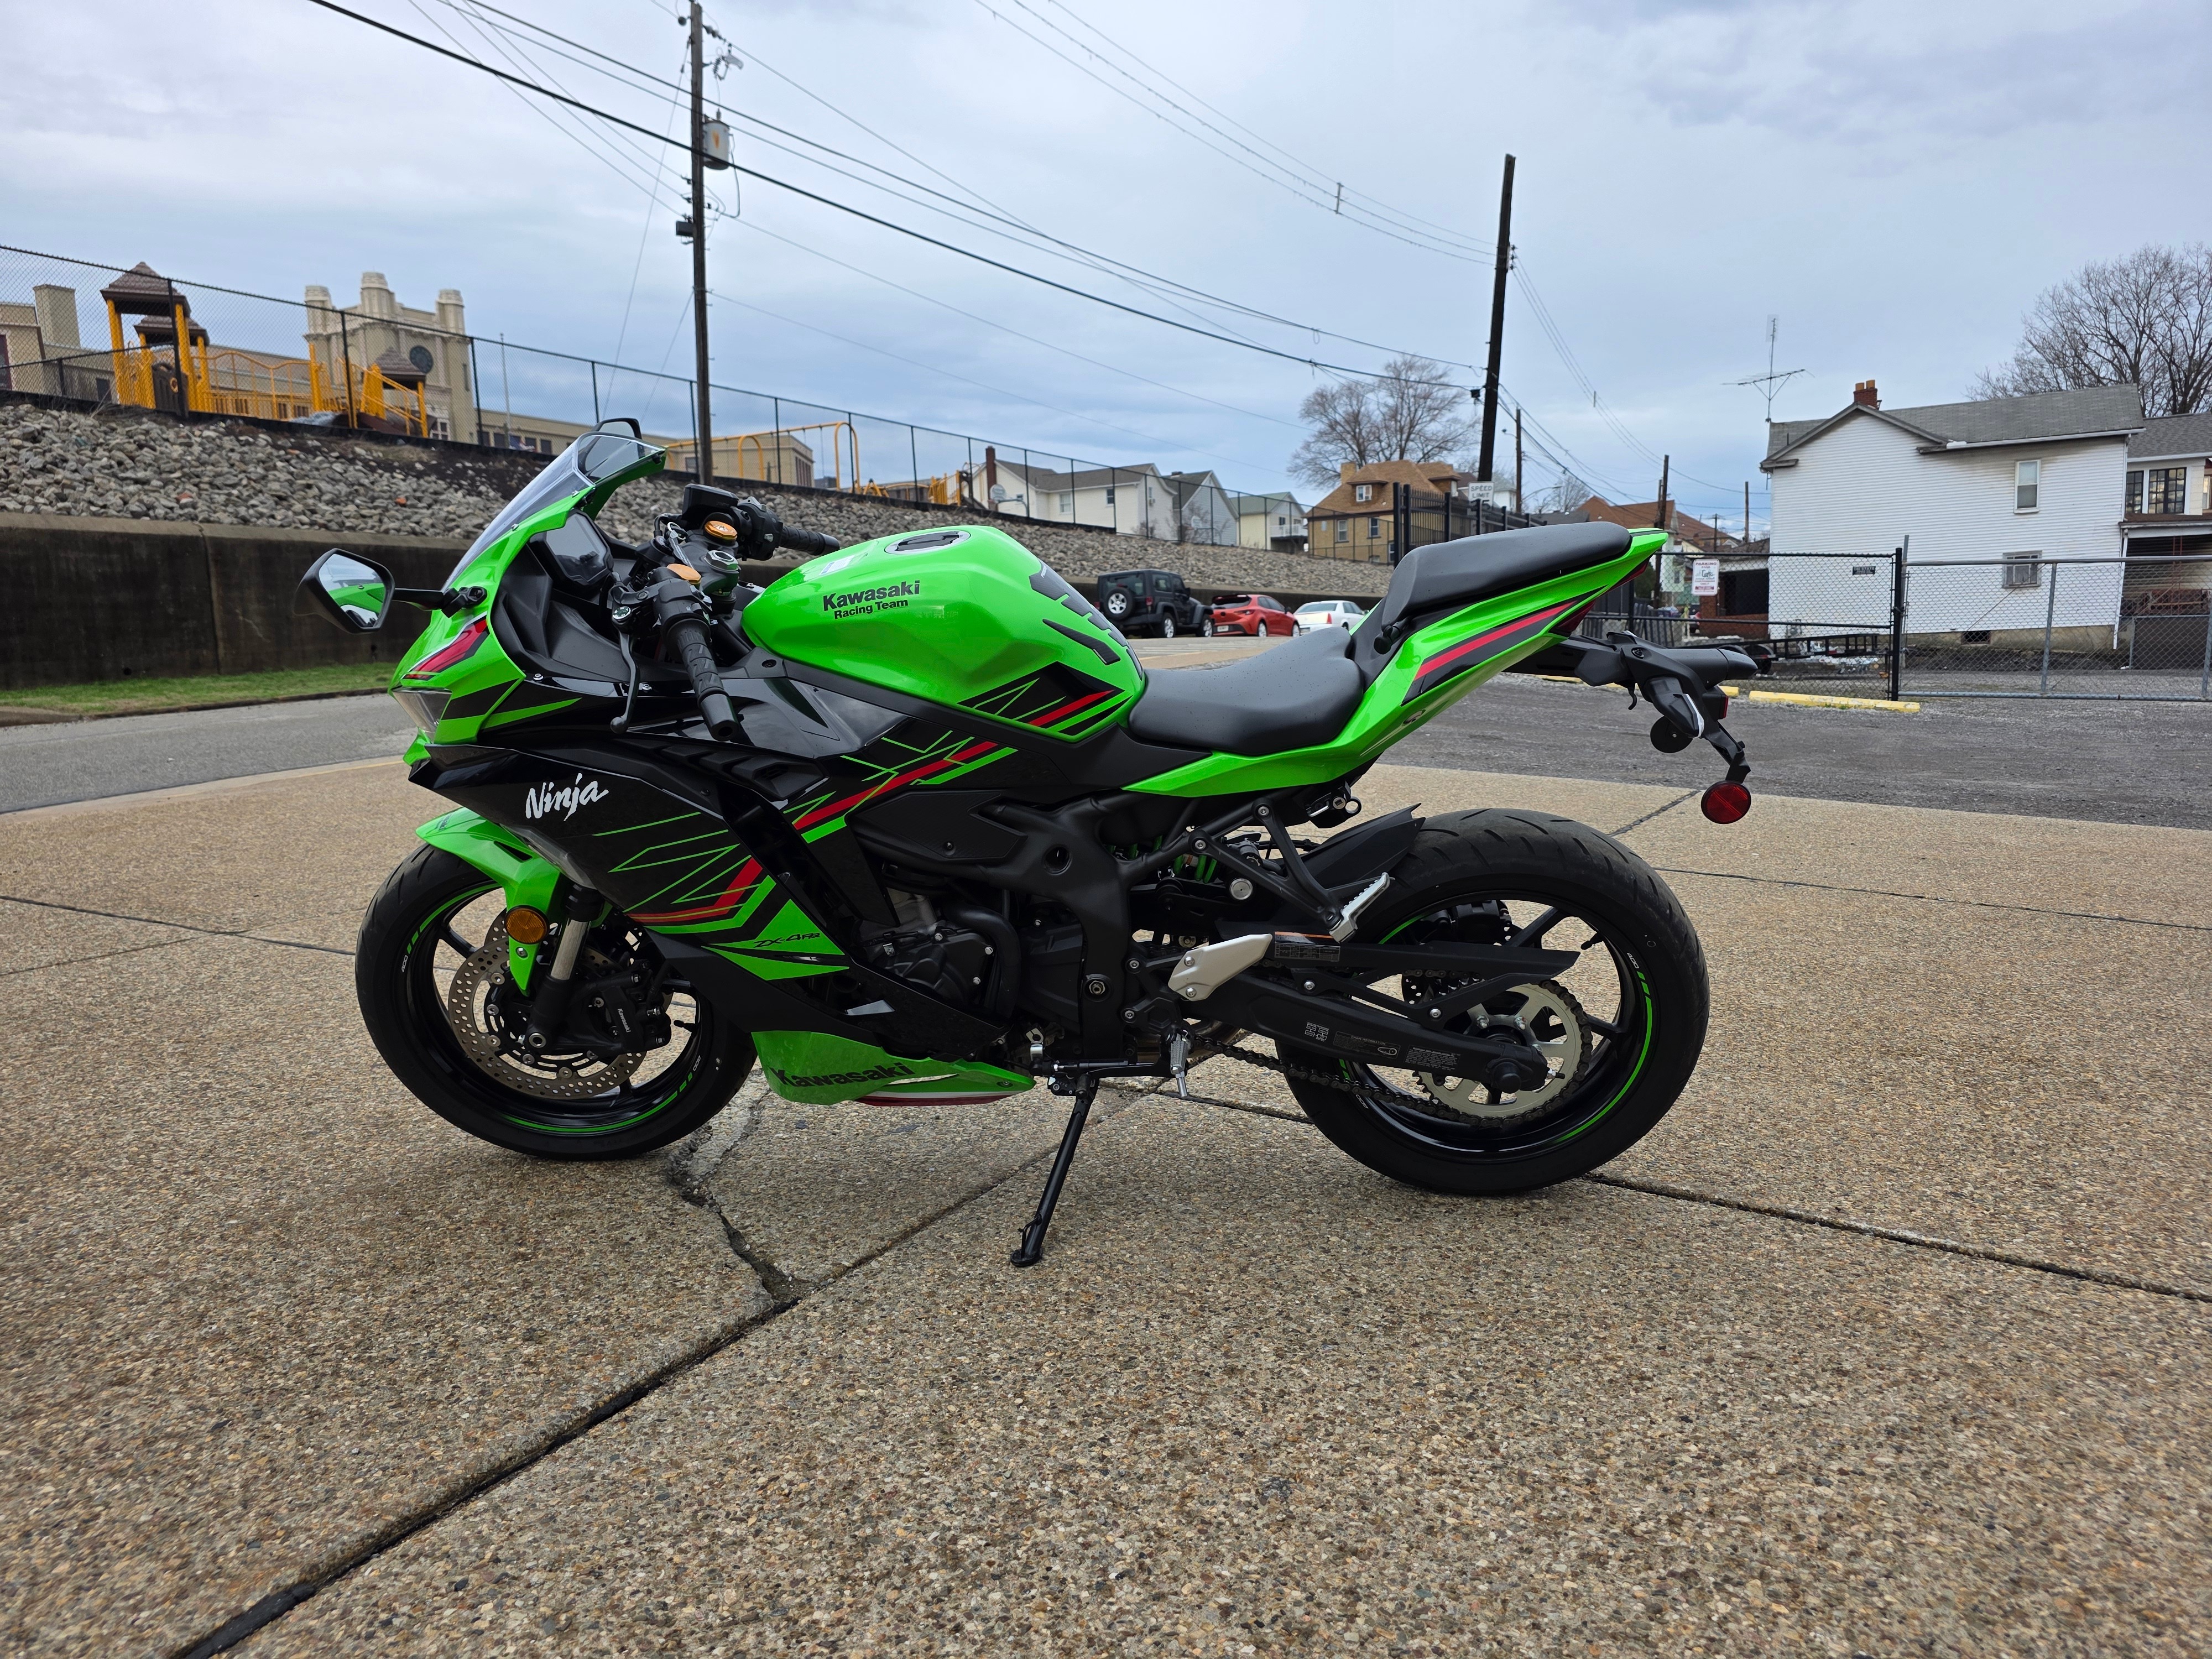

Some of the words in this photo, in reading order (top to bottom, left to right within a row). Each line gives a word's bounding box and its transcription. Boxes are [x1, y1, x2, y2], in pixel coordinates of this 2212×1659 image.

[823, 580, 920, 611] Kawasaki
[834, 605, 873, 619] Racing
[875, 599, 908, 611] Team
[525, 773, 609, 821] Ninja
[753, 933, 821, 948] ZX-4RR
[1627, 952, 1639, 968] 400
[618, 1009, 631, 1032] Kawasaki
[770, 1062, 915, 1087] Kawasaki
[1356, 1094, 1369, 1109] 400
